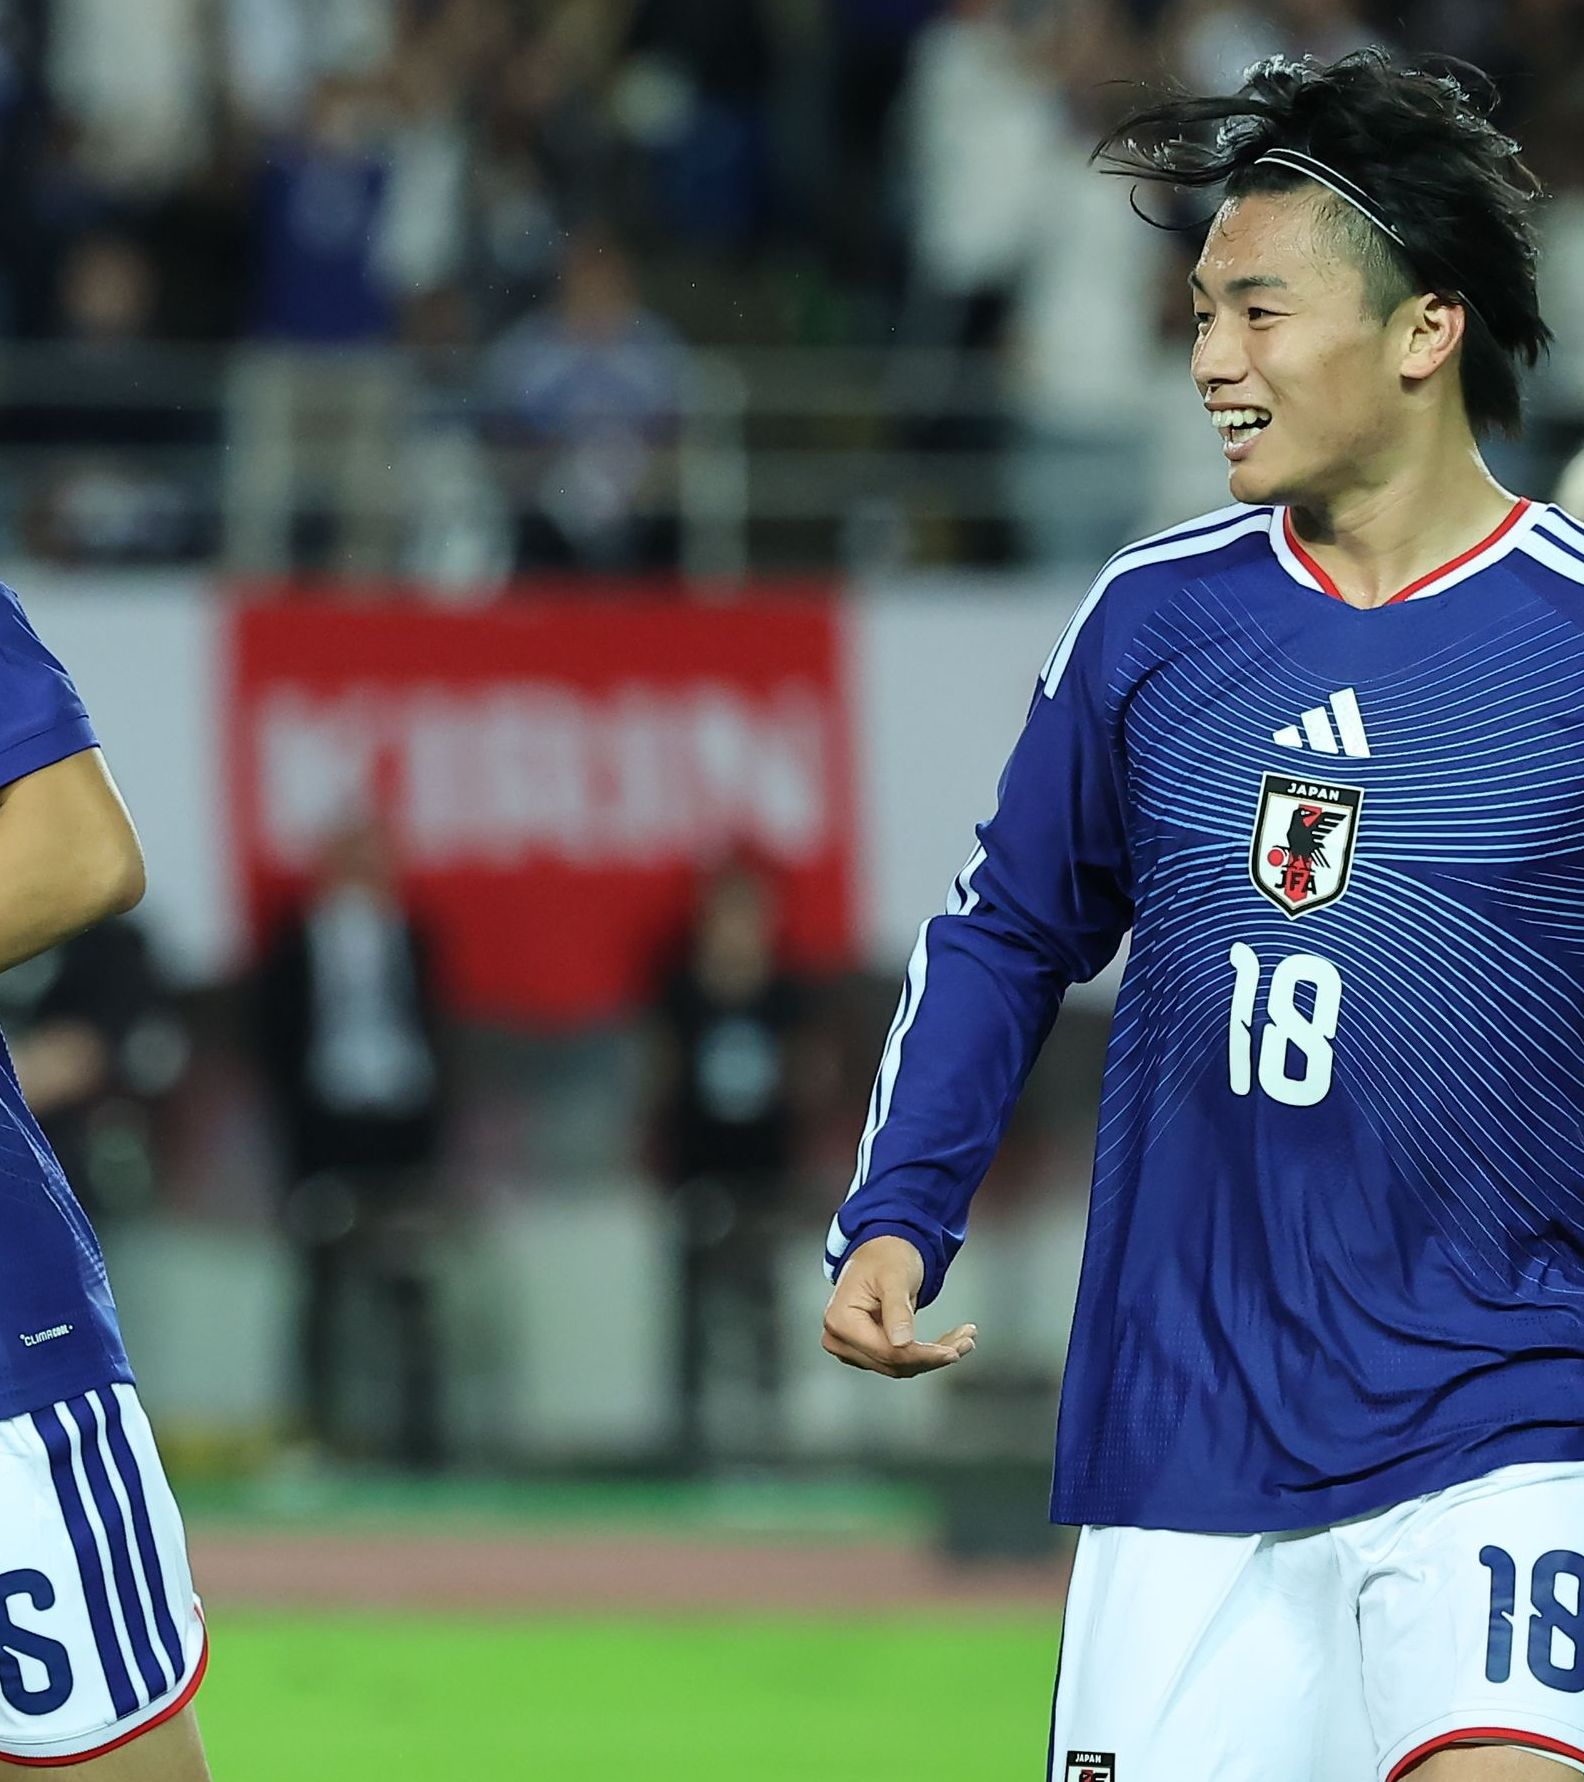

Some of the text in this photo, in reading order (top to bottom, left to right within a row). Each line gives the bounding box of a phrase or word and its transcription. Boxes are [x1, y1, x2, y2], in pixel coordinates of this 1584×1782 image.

[1286, 782, 1340, 802] JAPAN
[1273, 869, 1318, 896] JFA
[1228, 941, 1342, 1107] 18
[1478, 1544, 1584, 1693] 18
[1074, 1752, 1102, 1764] JAPAN
